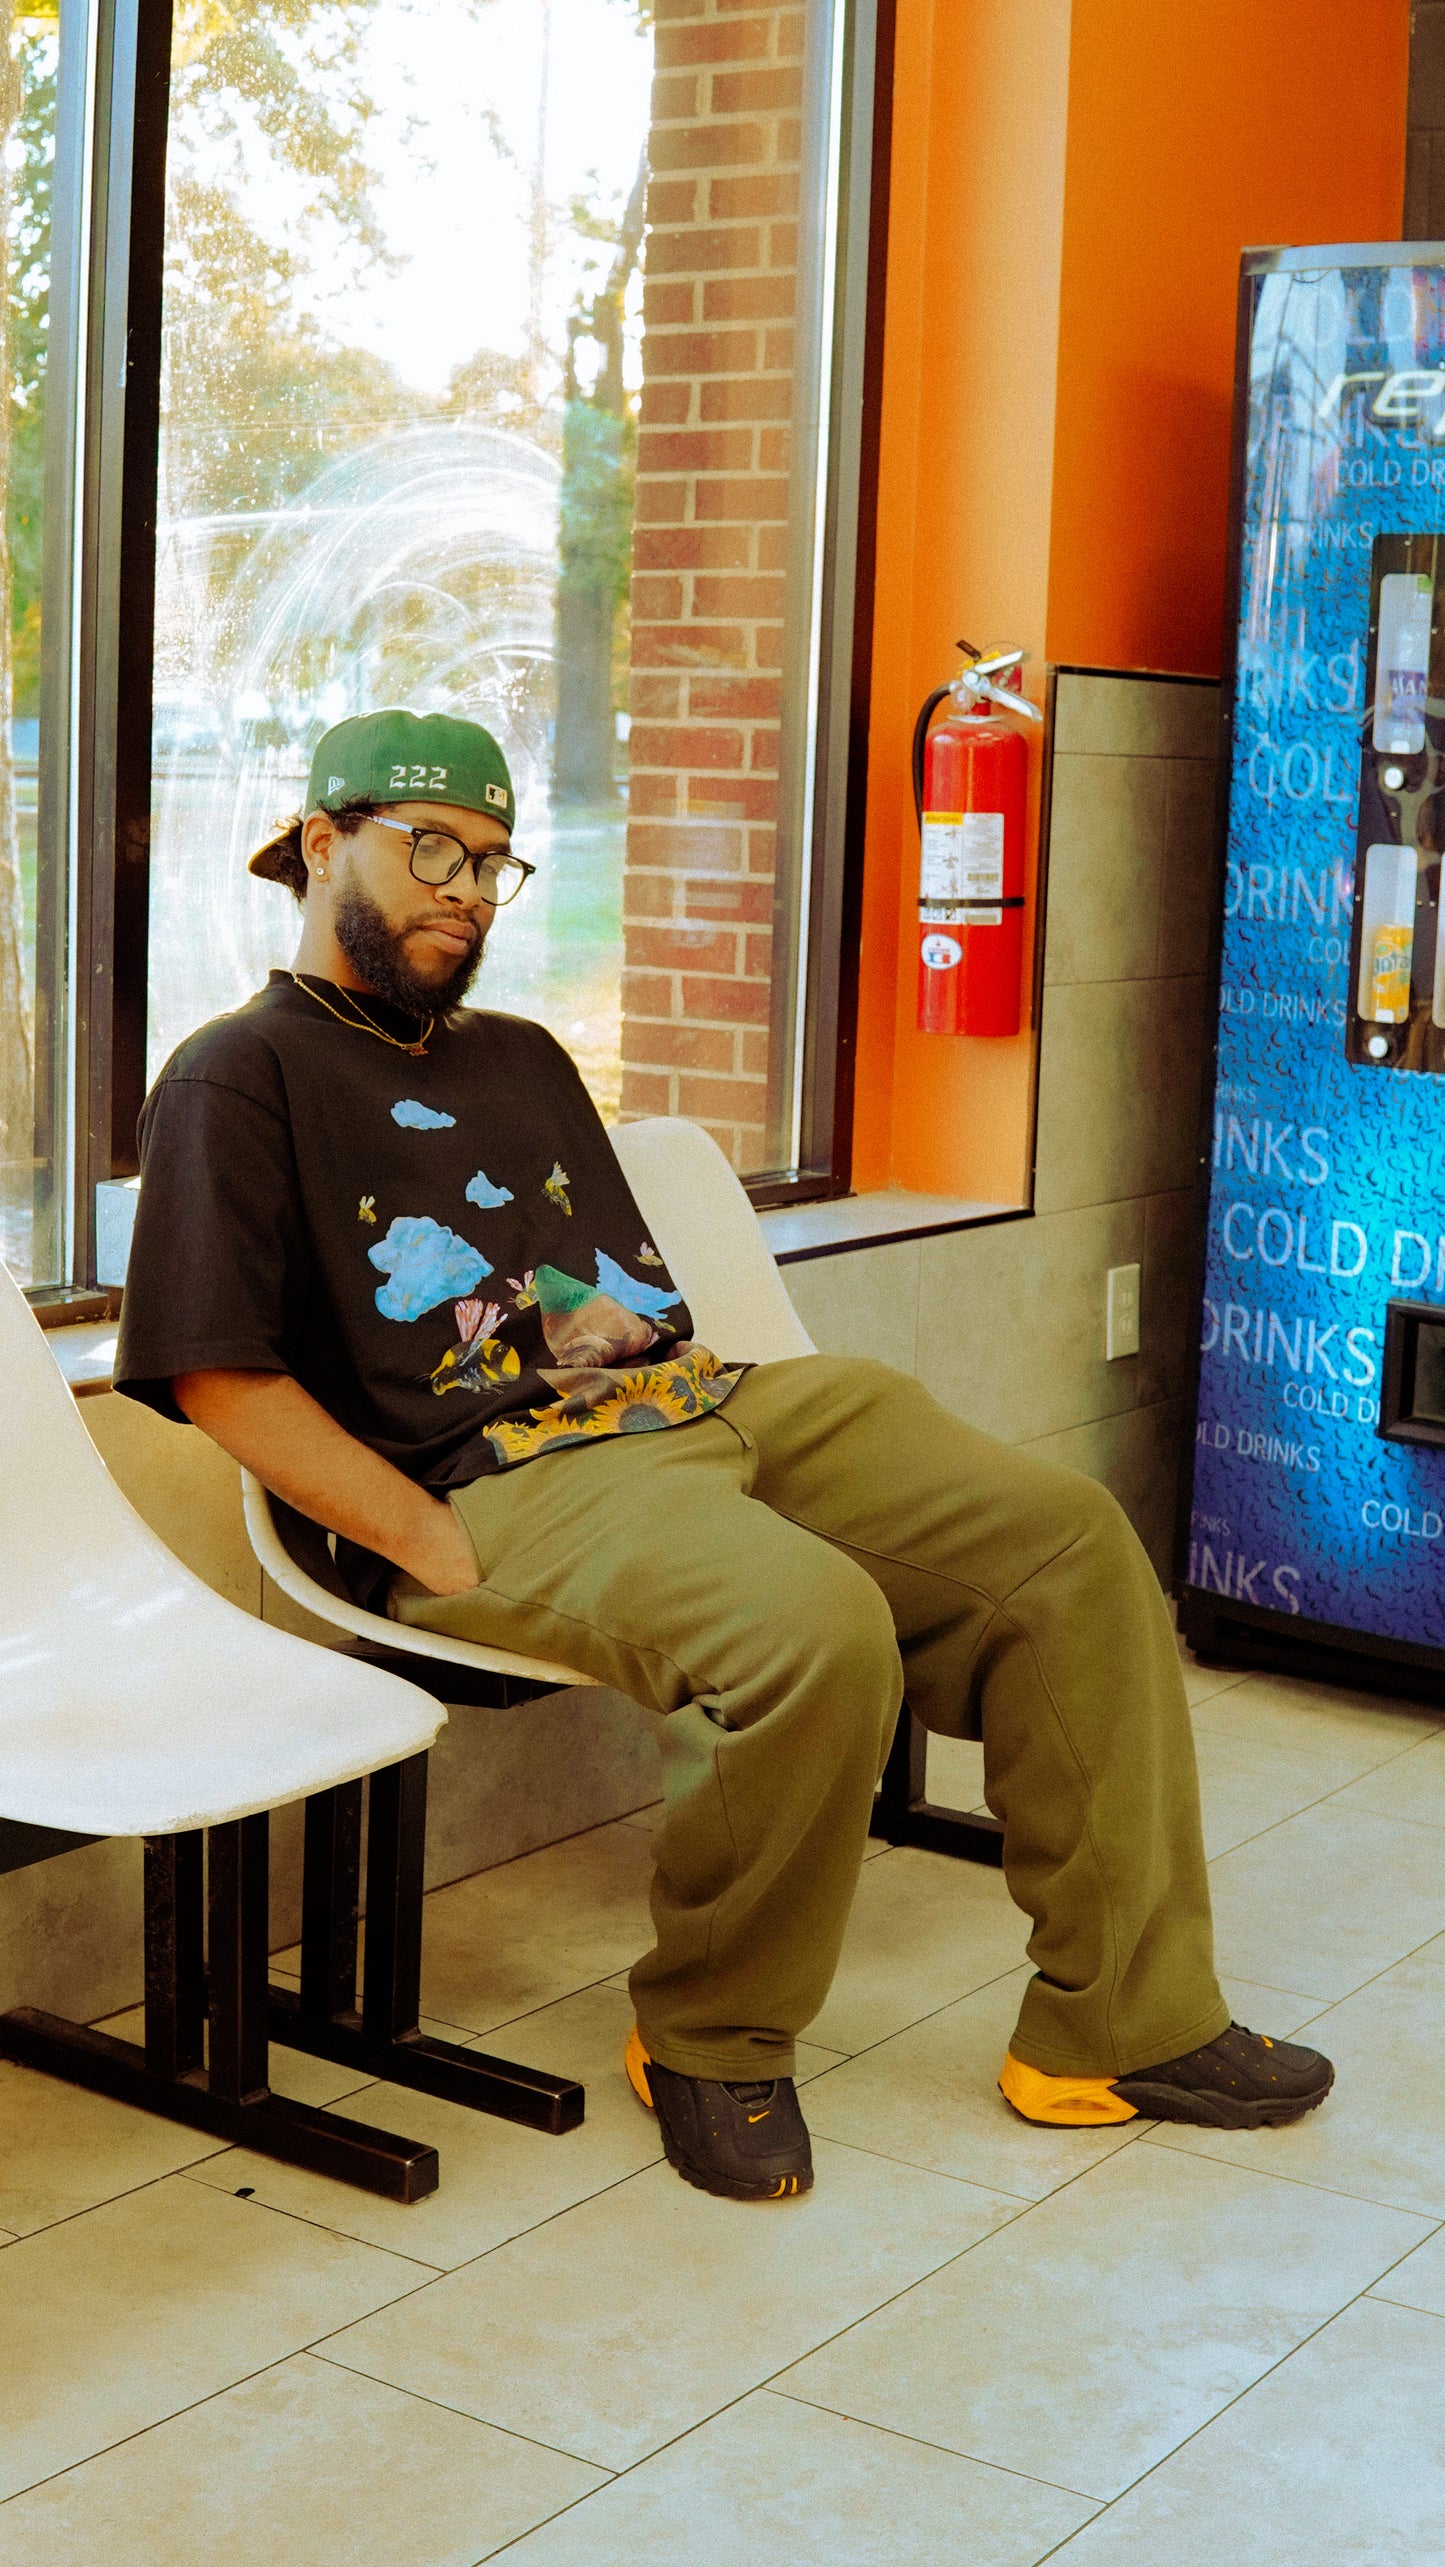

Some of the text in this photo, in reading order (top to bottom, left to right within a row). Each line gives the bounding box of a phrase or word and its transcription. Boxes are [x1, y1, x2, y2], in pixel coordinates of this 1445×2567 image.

[1317, 369, 1445, 436] re
[388, 764, 447, 790] 222
[1263, 990, 1347, 1028] DRINKS
[1213, 1112, 1329, 1186] INKS
[1223, 1201, 1368, 1278] COLD
[1283, 1382, 1348, 1418] COLD
[1238, 1431, 1320, 1473] DRINKS
[1361, 1499, 1443, 1540] COLD
